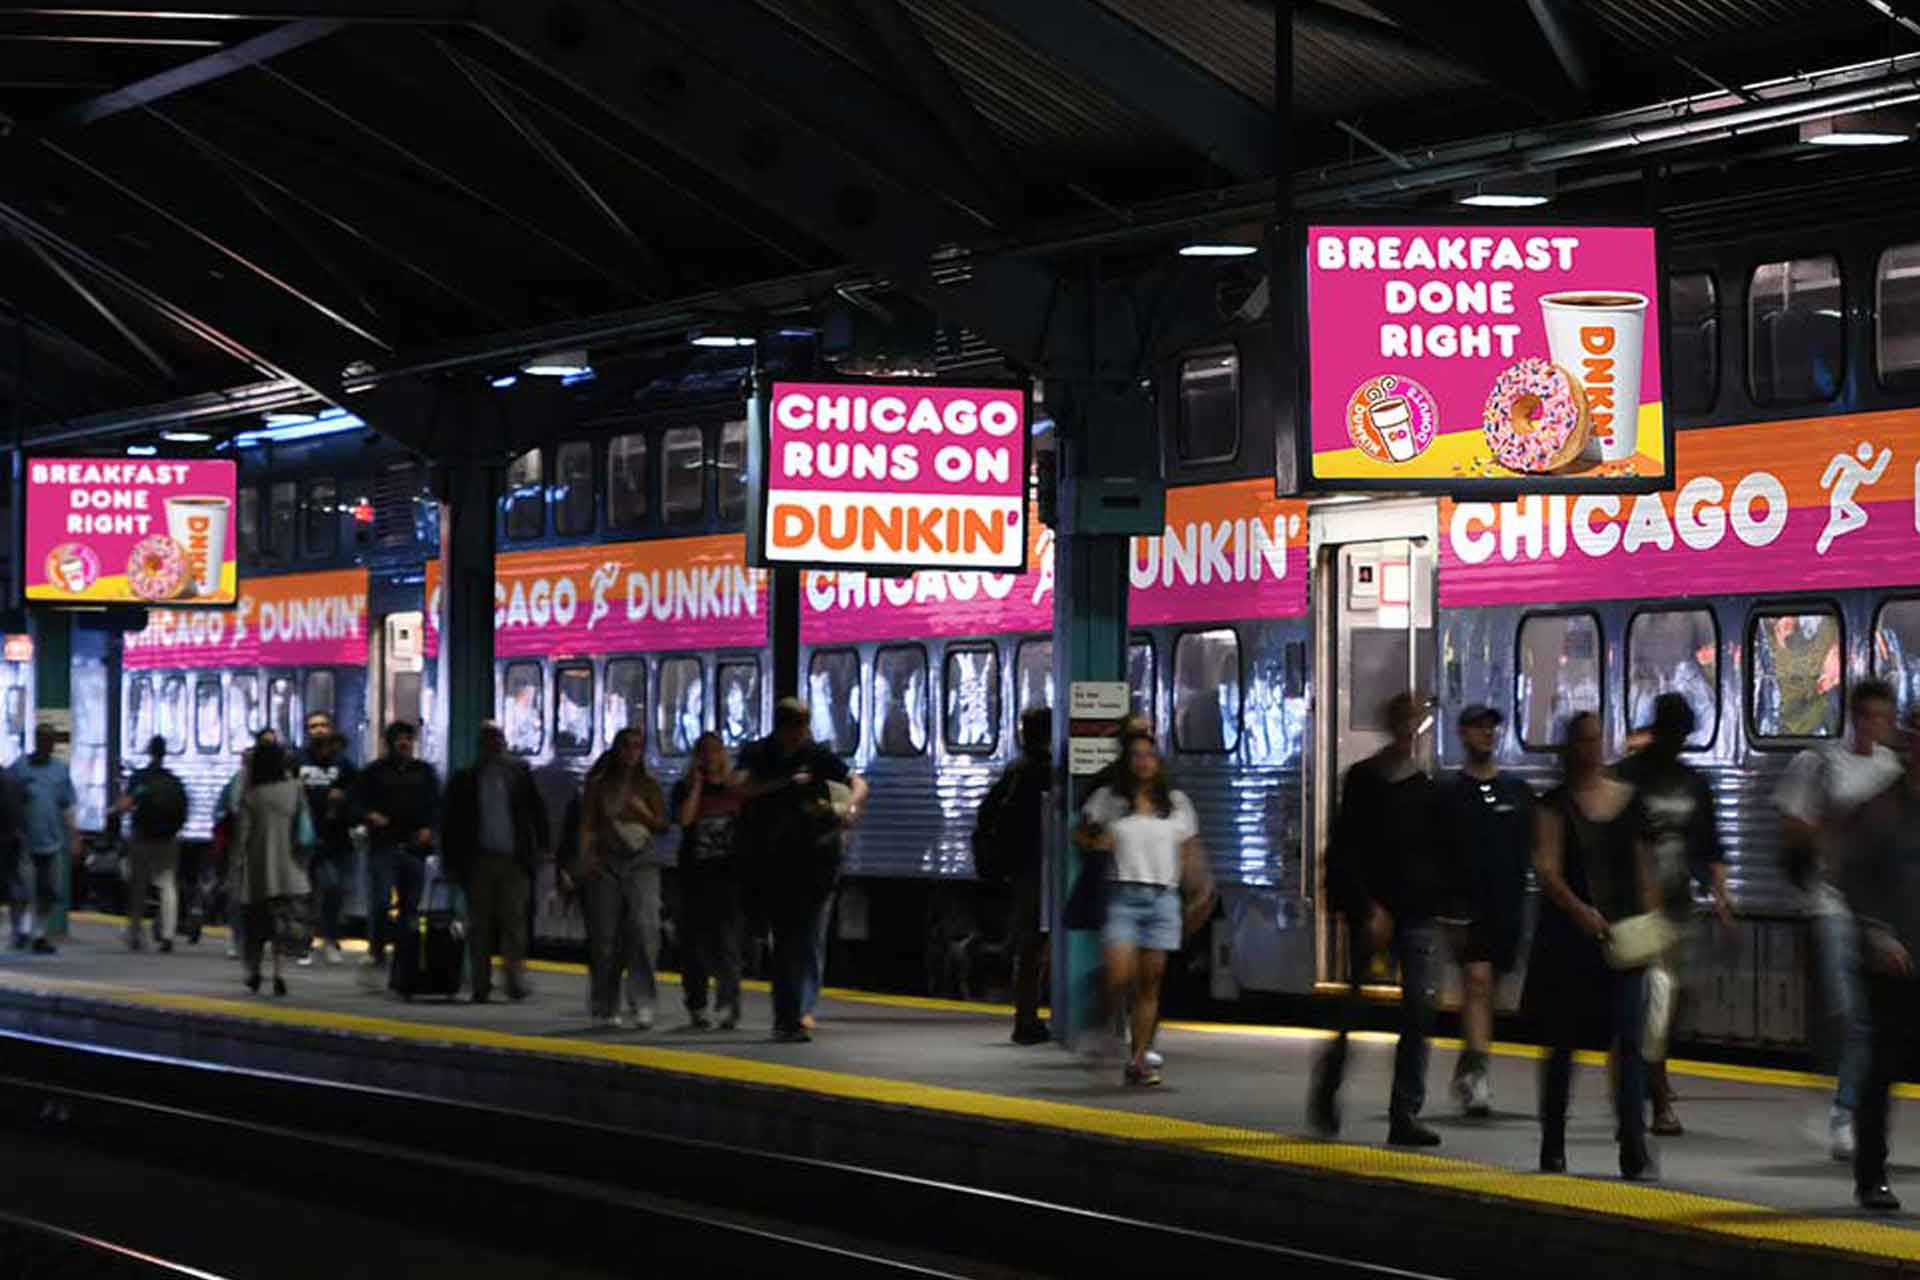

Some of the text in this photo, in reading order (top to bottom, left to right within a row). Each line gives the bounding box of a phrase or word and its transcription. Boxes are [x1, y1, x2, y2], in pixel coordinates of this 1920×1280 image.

[1317, 236, 1579, 271] BREAKFAST
[1384, 280, 1516, 315] DONE
[1379, 324, 1521, 358] RIGHT
[777, 394, 1018, 436] CHICAGO
[32, 465, 190, 484] BREAKFAST
[783, 441, 1010, 483] RUNS ON
[71, 490, 148, 509] DONE
[67, 515, 151, 534] RIGHT
[772, 504, 1019, 554] DUNKIN'
[1449, 471, 1789, 564] CHICAGO
[1130, 514, 1300, 589] UNKIN'
